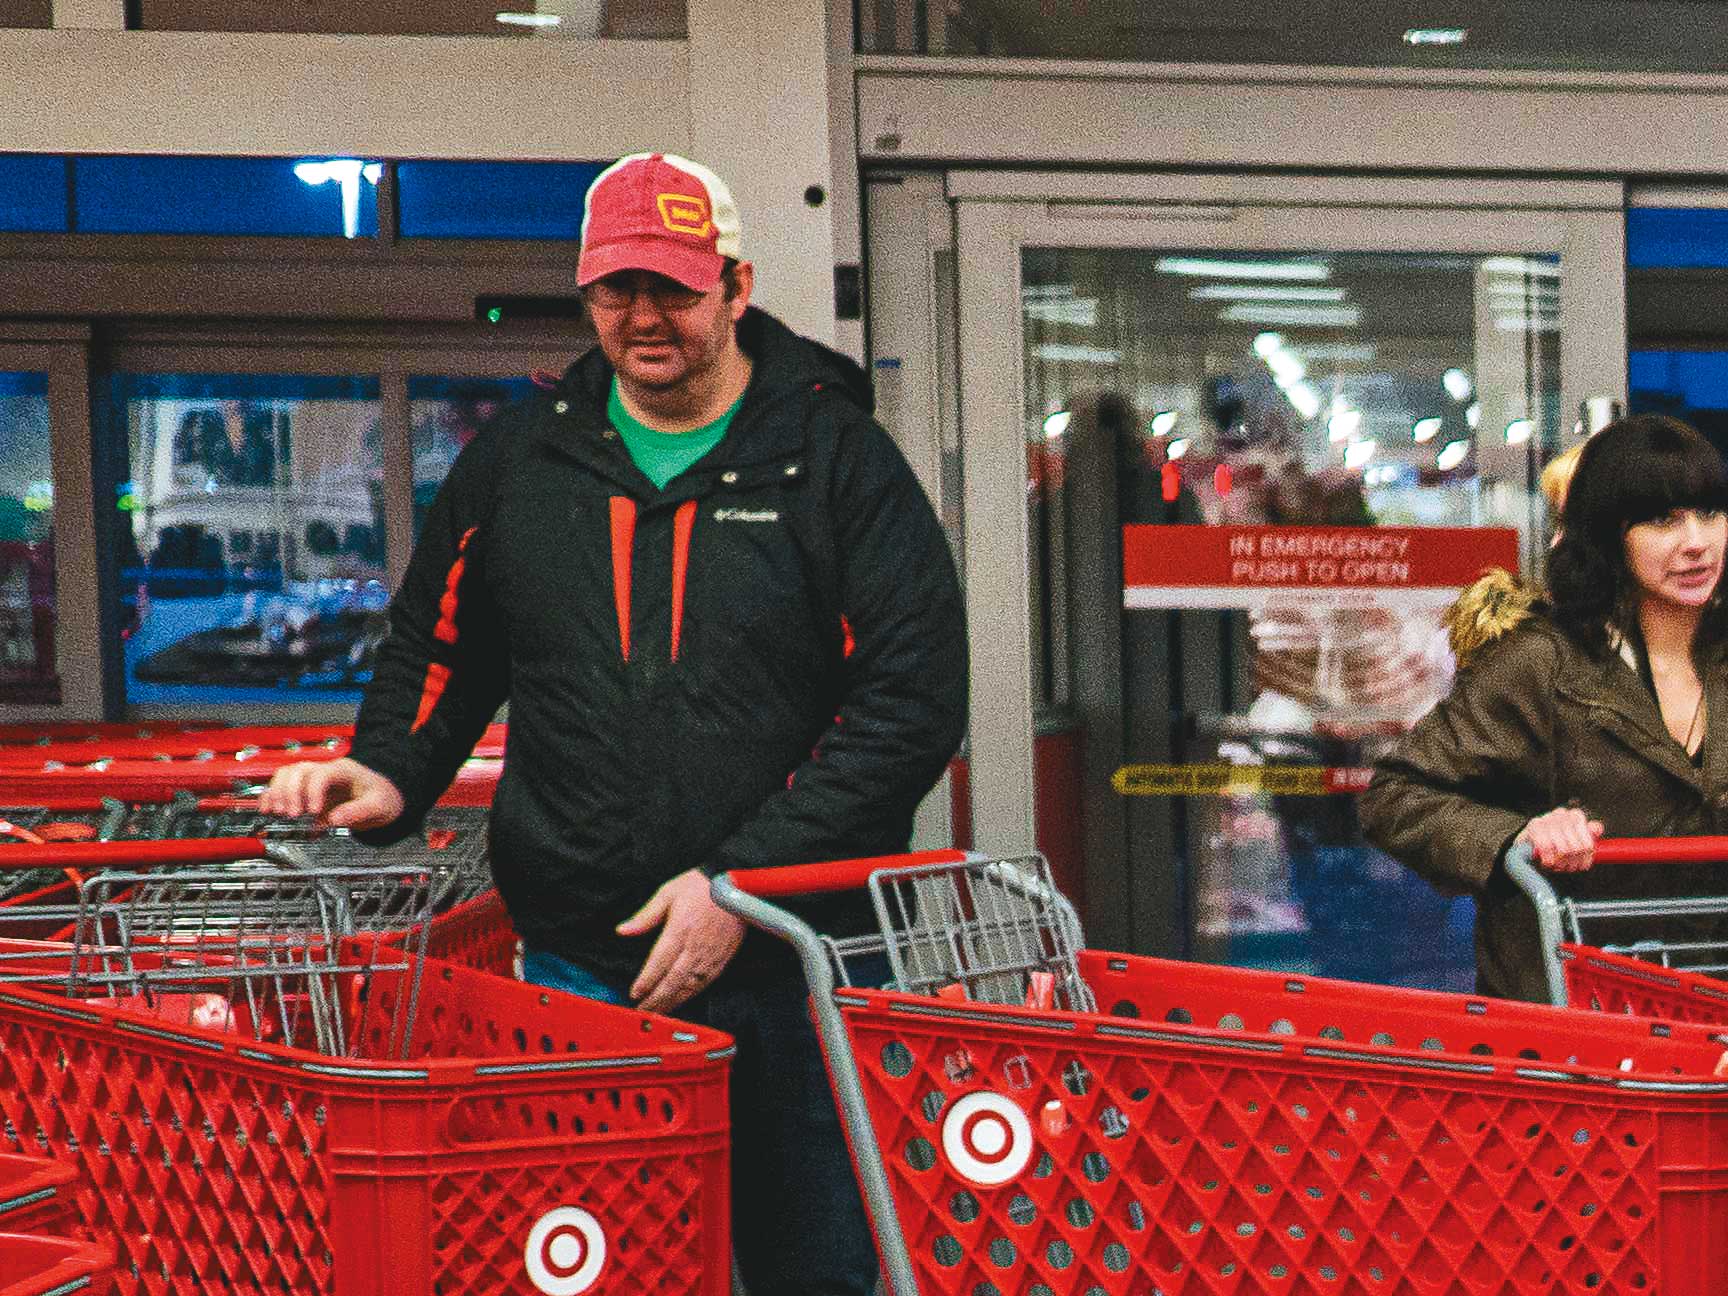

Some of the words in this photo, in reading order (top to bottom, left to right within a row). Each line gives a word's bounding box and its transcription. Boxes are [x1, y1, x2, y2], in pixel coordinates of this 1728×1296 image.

[1230, 536, 1252, 556] IN
[1260, 535, 1409, 557] EMERGENCY
[1232, 560, 1298, 581] PUSH
[1308, 561, 1337, 581] TO
[1342, 560, 1409, 581] OPEN
